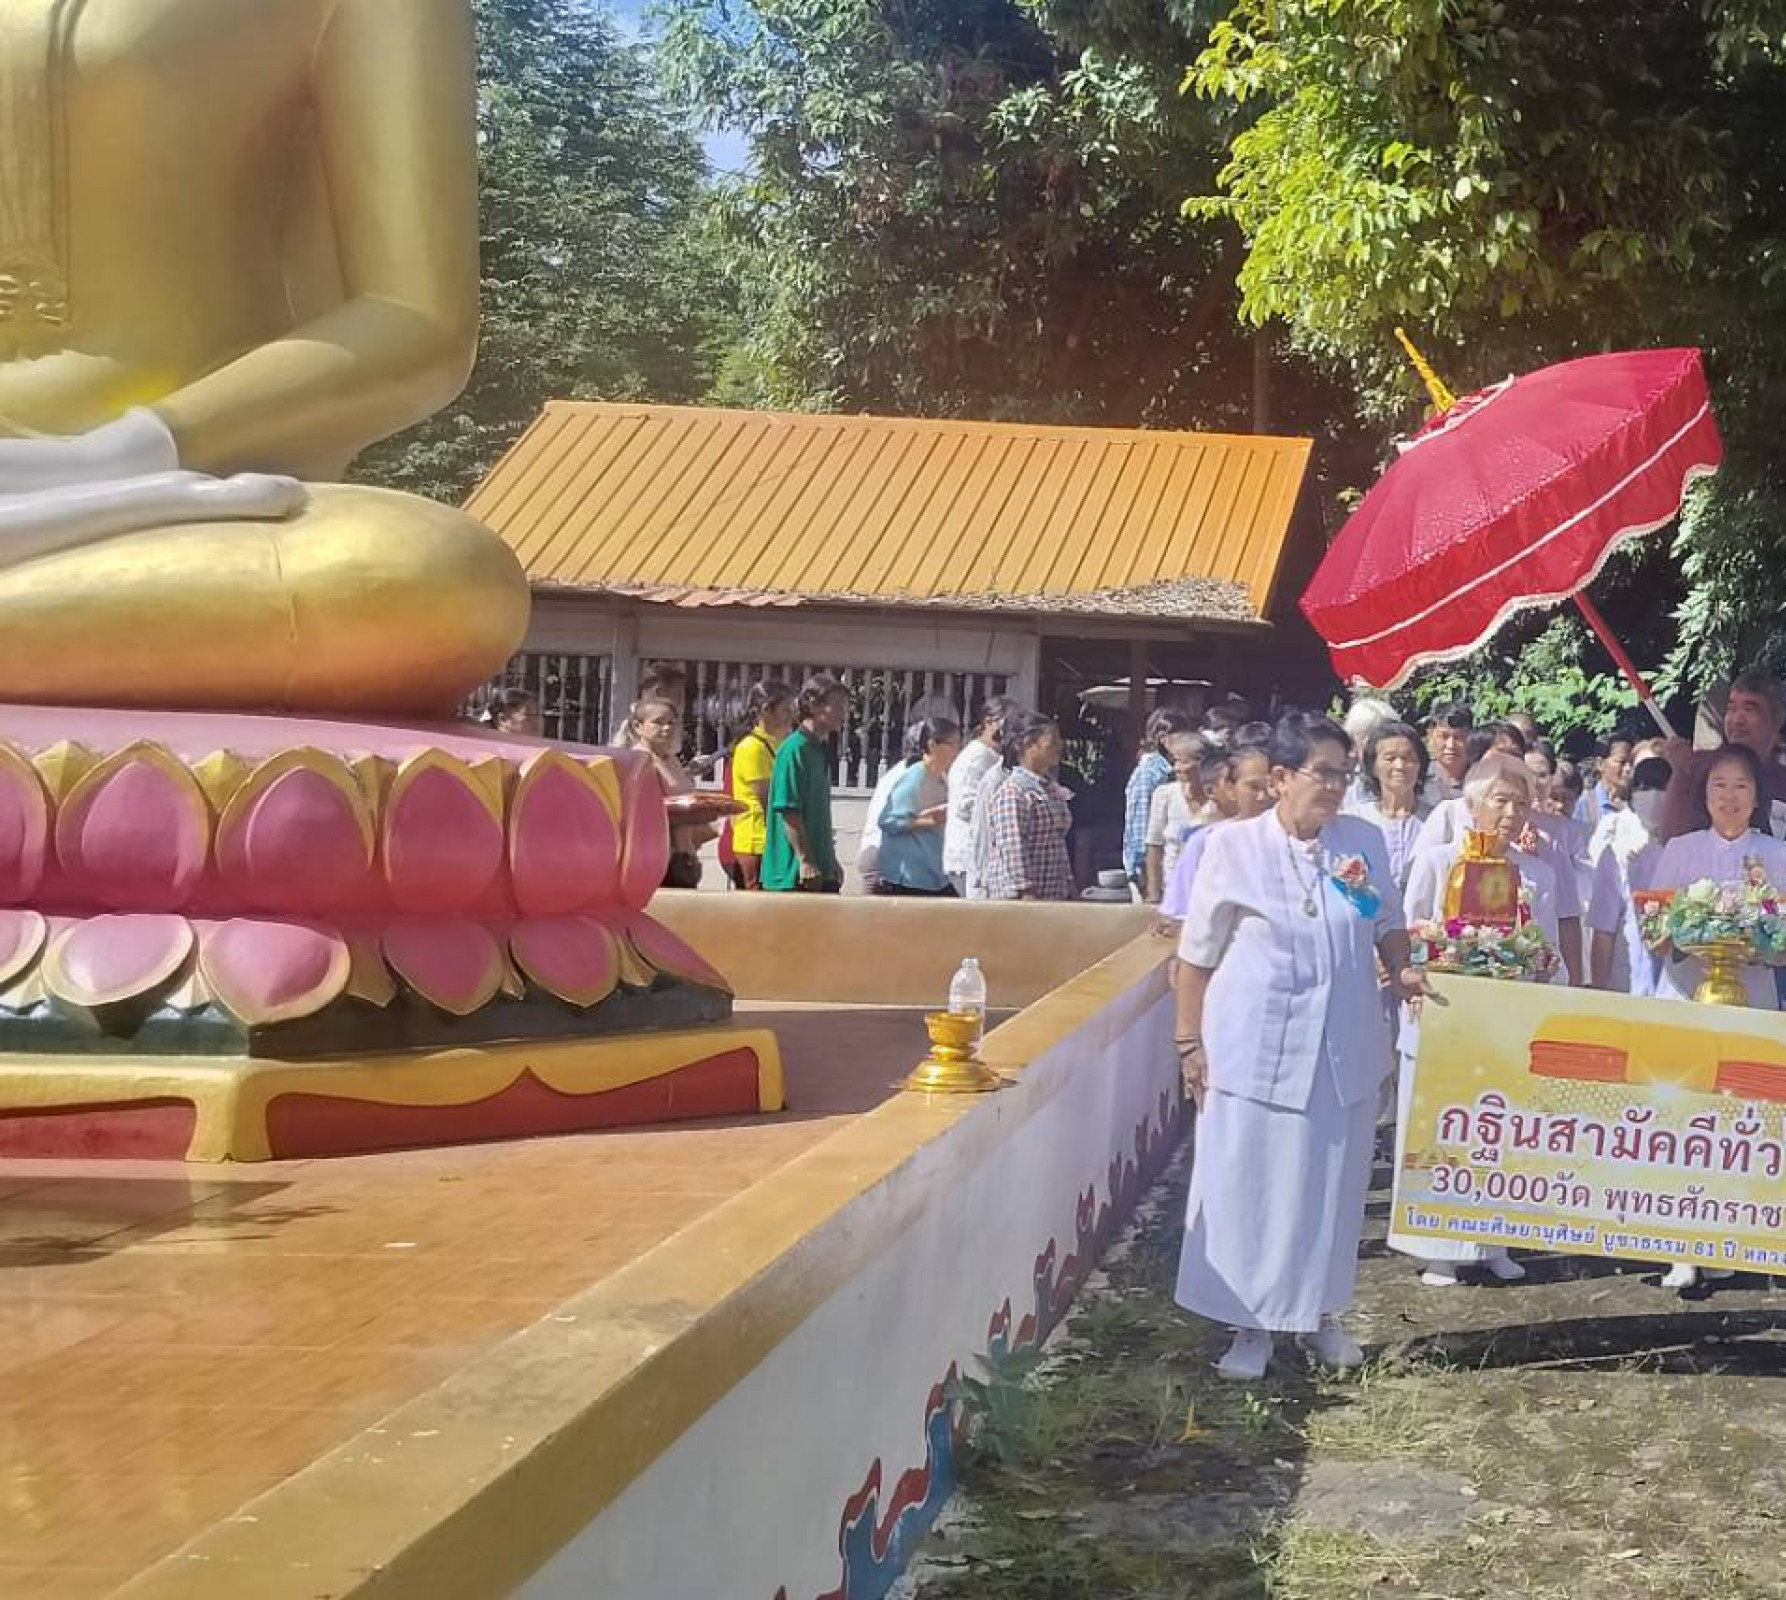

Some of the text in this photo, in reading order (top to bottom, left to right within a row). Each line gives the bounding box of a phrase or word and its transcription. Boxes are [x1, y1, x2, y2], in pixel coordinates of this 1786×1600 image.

[1432, 1166, 1590, 1210] 30,000วัด
[1604, 1178, 1781, 1229] พุทธศักราช
[1405, 1207, 1440, 1229] โดย
[1695, 1241, 1715, 1257] 81
[1723, 1240, 1737, 1259] ปี
